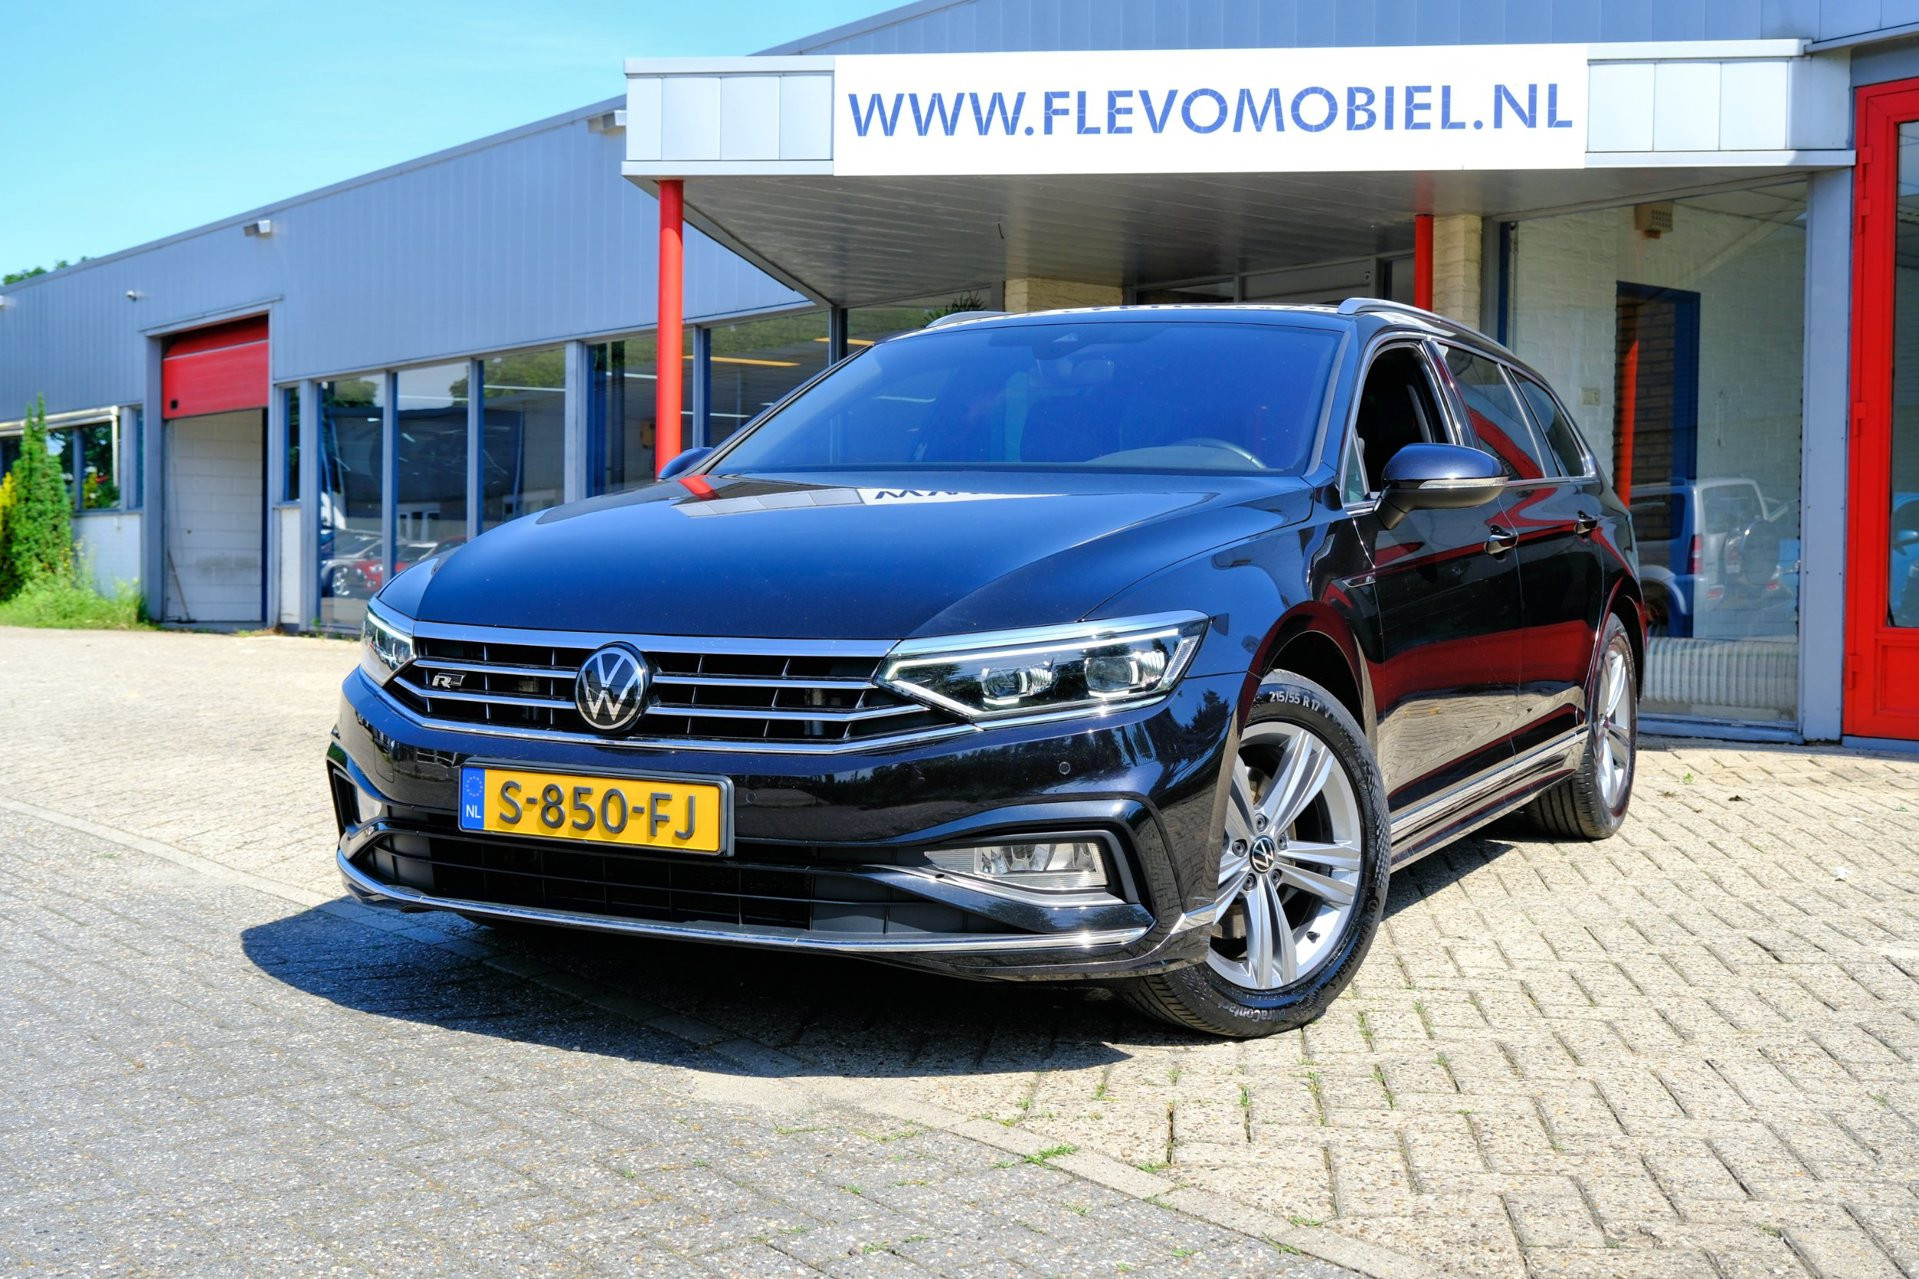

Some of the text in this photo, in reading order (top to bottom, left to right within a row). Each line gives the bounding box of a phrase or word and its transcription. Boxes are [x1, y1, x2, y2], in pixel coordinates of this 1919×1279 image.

[848, 83, 1573, 137] WWW.FLEVOMOBIEL.NL
[1269, 691, 1300, 705] 215/55
[466, 804, 482, 819] NL
[499, 780, 696, 840] S-850-FJ
